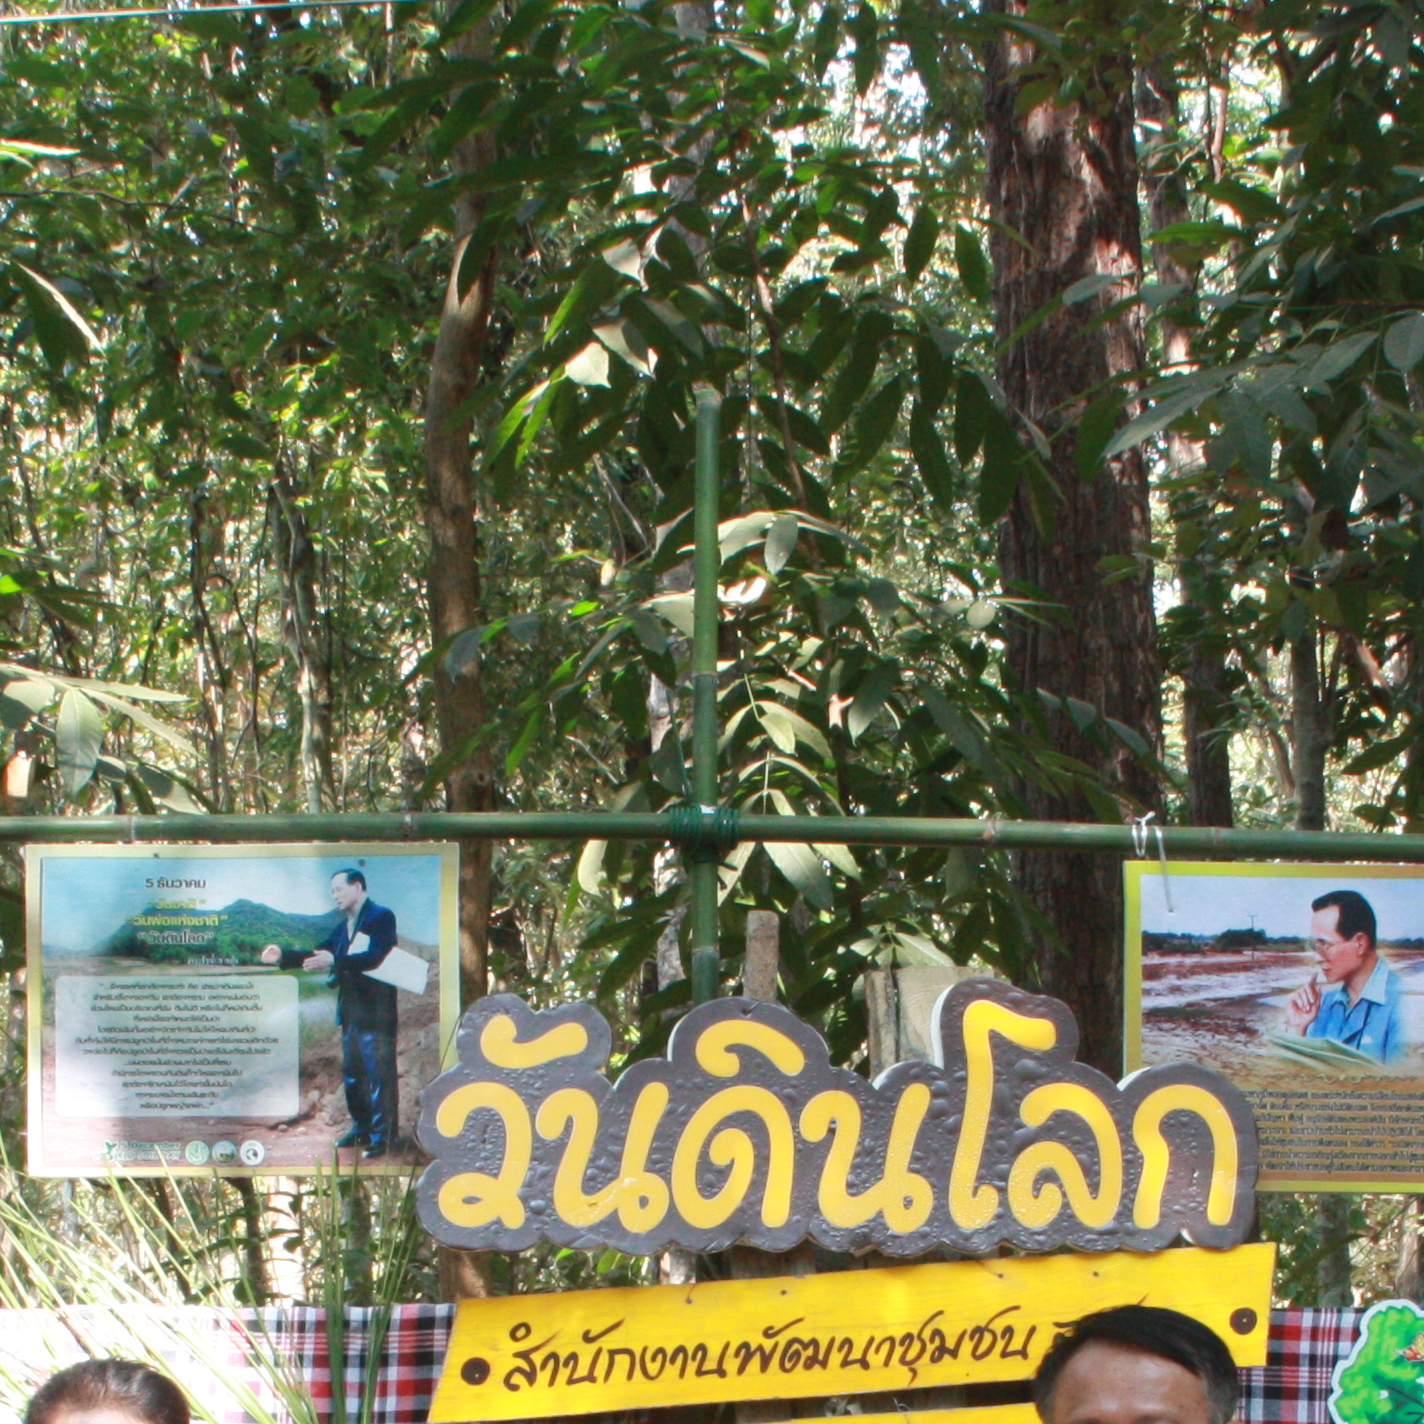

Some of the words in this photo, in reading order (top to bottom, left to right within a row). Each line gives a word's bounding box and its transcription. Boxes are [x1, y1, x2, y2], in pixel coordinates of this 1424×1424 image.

[157, 877, 207, 889] ธันวาคม
[432, 998, 1240, 1236] วันดินโลก
[502, 1305, 1037, 1392] สำนักงานพัฒนาชุมชน
